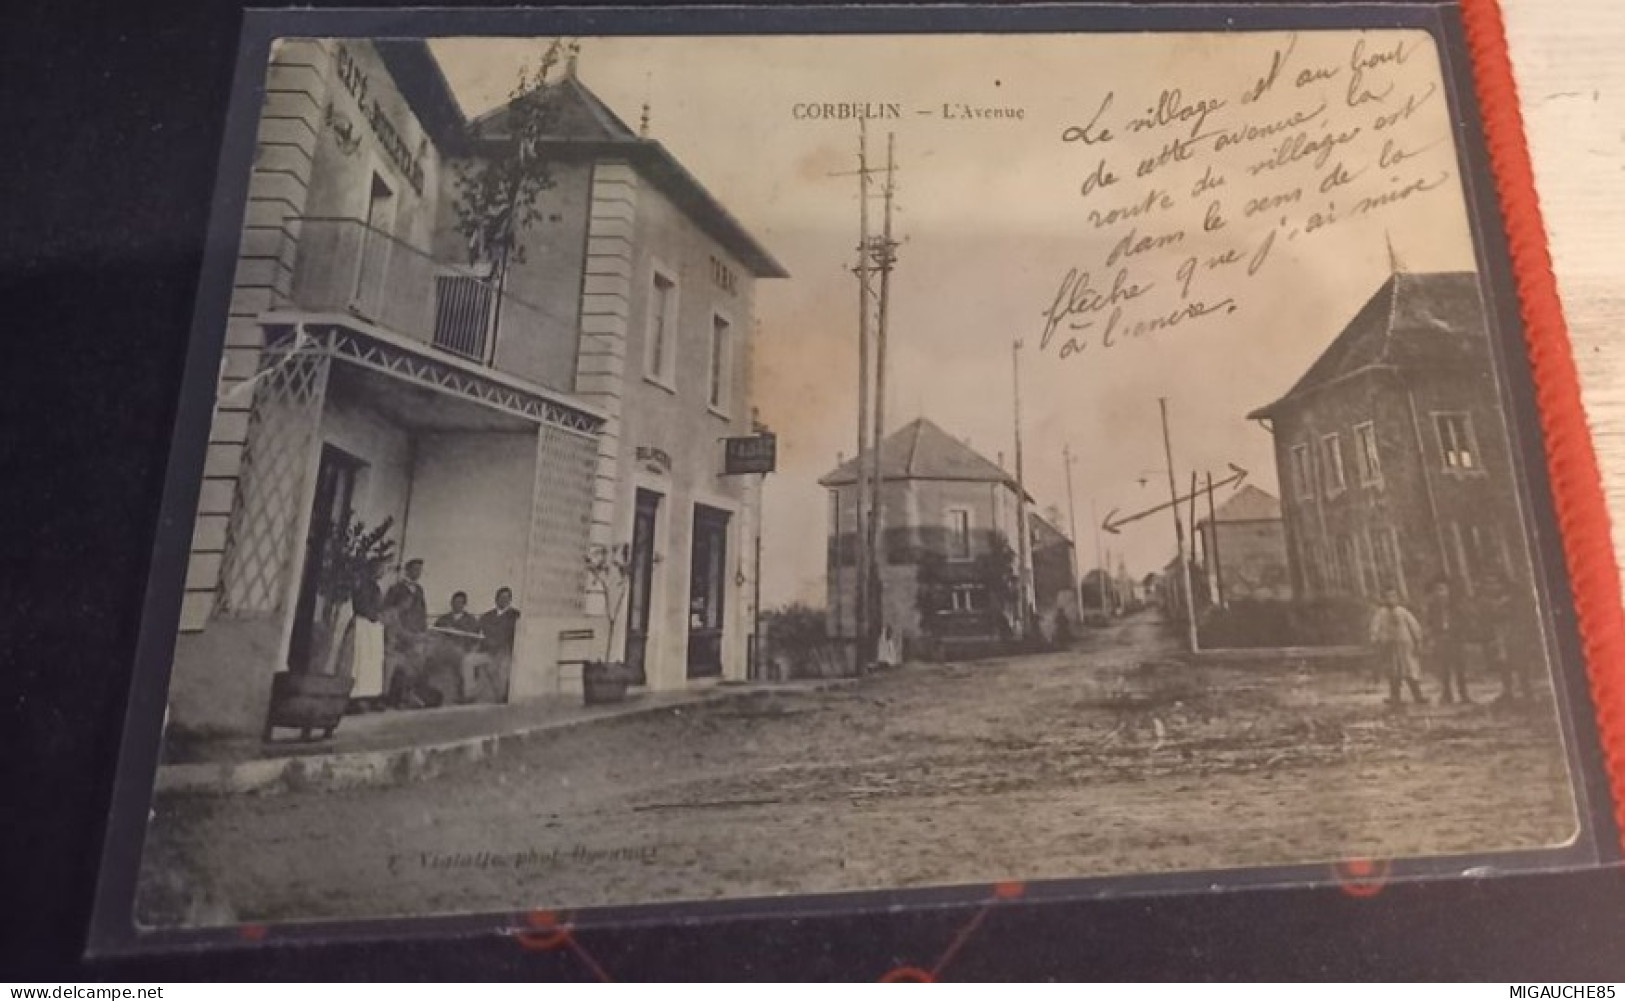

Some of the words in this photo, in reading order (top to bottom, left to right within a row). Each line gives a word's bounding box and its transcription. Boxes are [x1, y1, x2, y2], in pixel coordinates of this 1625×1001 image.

[792, 103, 902, 120] CORBELIN
[942, 103, 1026, 120] L'Avenue
[1062, 90, 1114, 145] Le
[1125, 88, 1228, 138] village
[1296, 67, 1340, 88] au
[1351, 38, 1410, 71] bout
[1081, 159, 1119, 196] de
[1137, 129, 1228, 177] cette
[1348, 70, 1395, 107] la
[1088, 188, 1174, 229] route
[1191, 166, 1225, 197] du
[1246, 131, 1360, 175] village
[1374, 81, 1438, 131] est
[1106, 227, 1185, 267] dans
[1203, 199, 1227, 231] le
[1245, 187, 1303, 217] sens
[1319, 161, 1360, 194] de
[1380, 138, 1432, 169] la
[1175, 251, 1247, 300] que
[1350, 171, 1449, 214] mise
